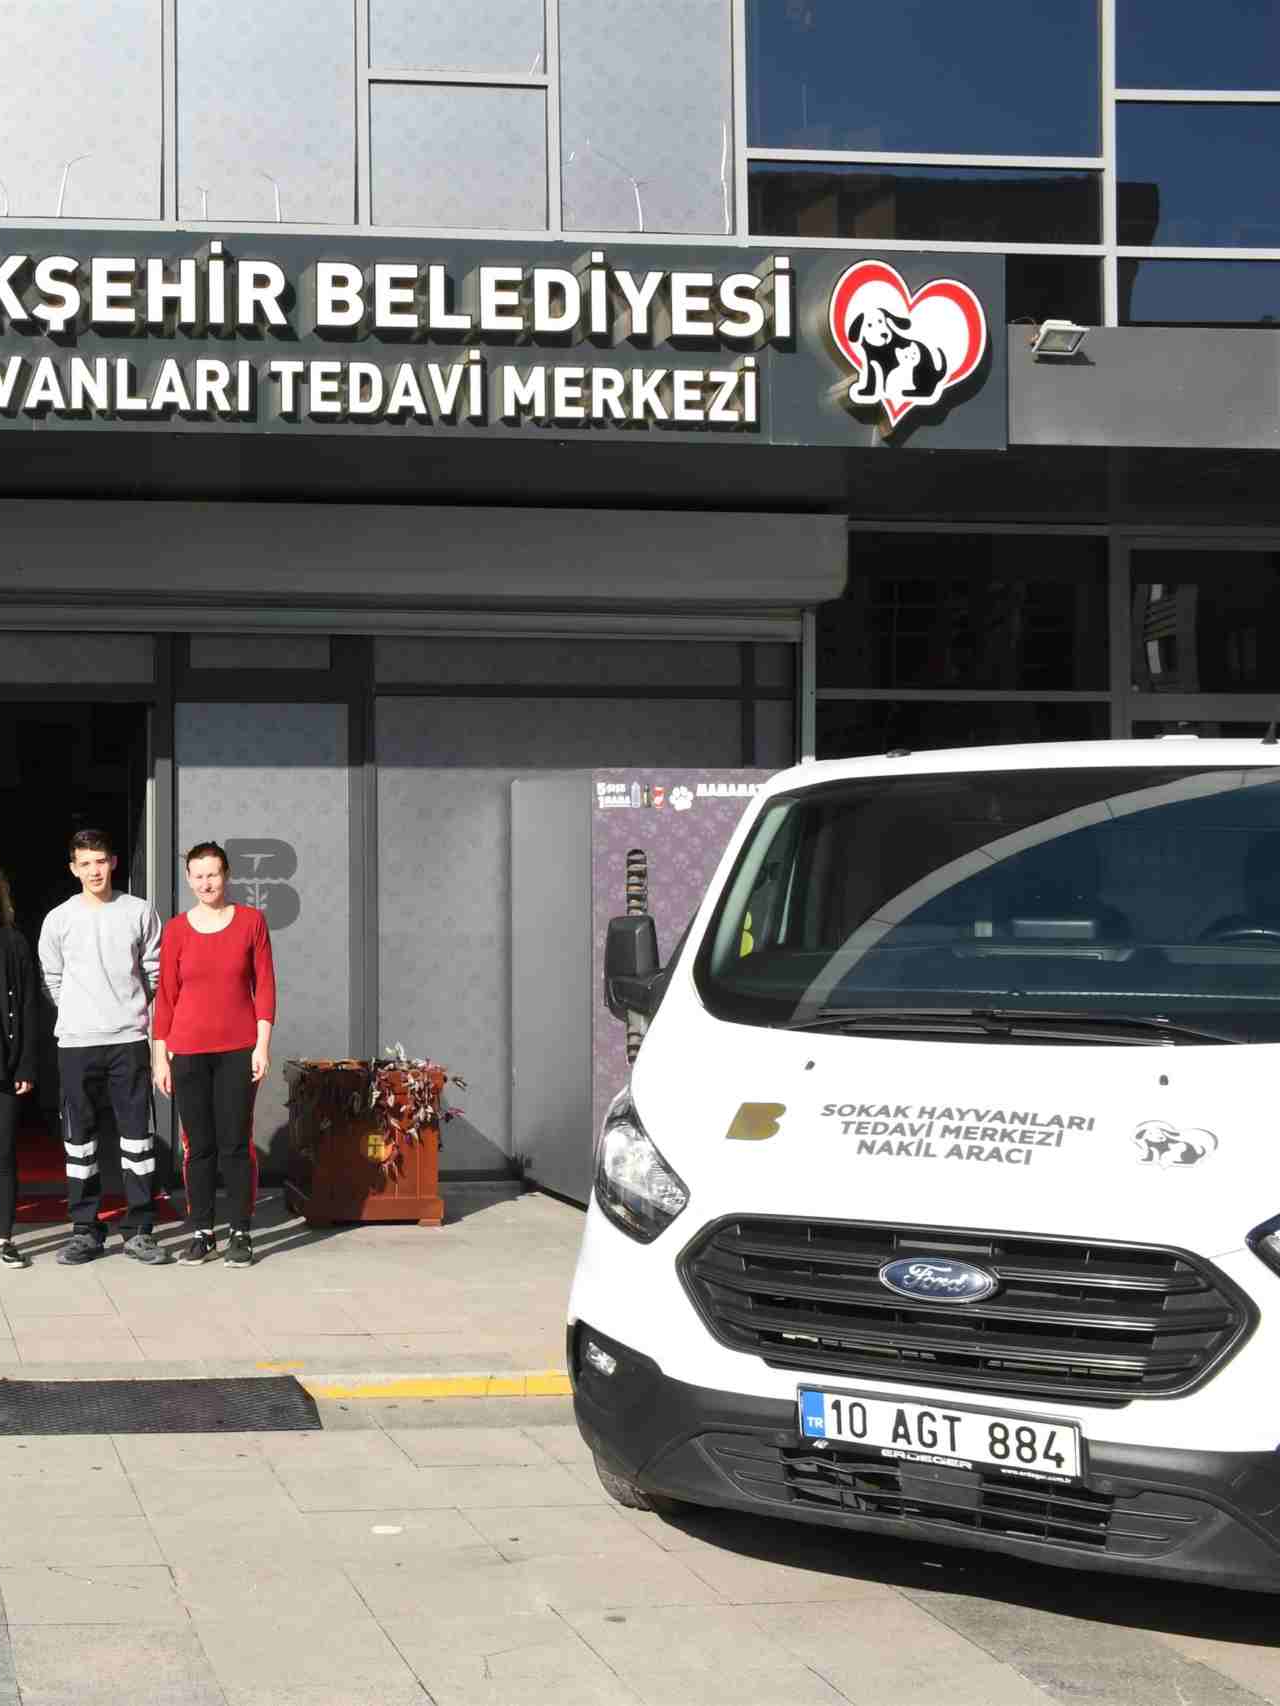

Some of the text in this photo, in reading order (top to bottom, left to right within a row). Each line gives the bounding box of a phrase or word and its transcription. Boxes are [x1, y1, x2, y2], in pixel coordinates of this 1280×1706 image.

[317, 251, 791, 338] BELEDİYESİ
[269, 350, 483, 416] TEDAVİ
[503, 356, 757, 423] MERKEZİ
[820, 1103, 1095, 1131] SOKAK HAYVANLARI
[840, 1120, 1064, 1148] TEDAVİ MERKEZİ
[856, 1138, 1033, 1165] NAKİL ARACI
[903, 1263, 969, 1292] Ford
[807, 1415, 824, 1429] TR
[831, 1399, 1065, 1469] 10 AGT 884
